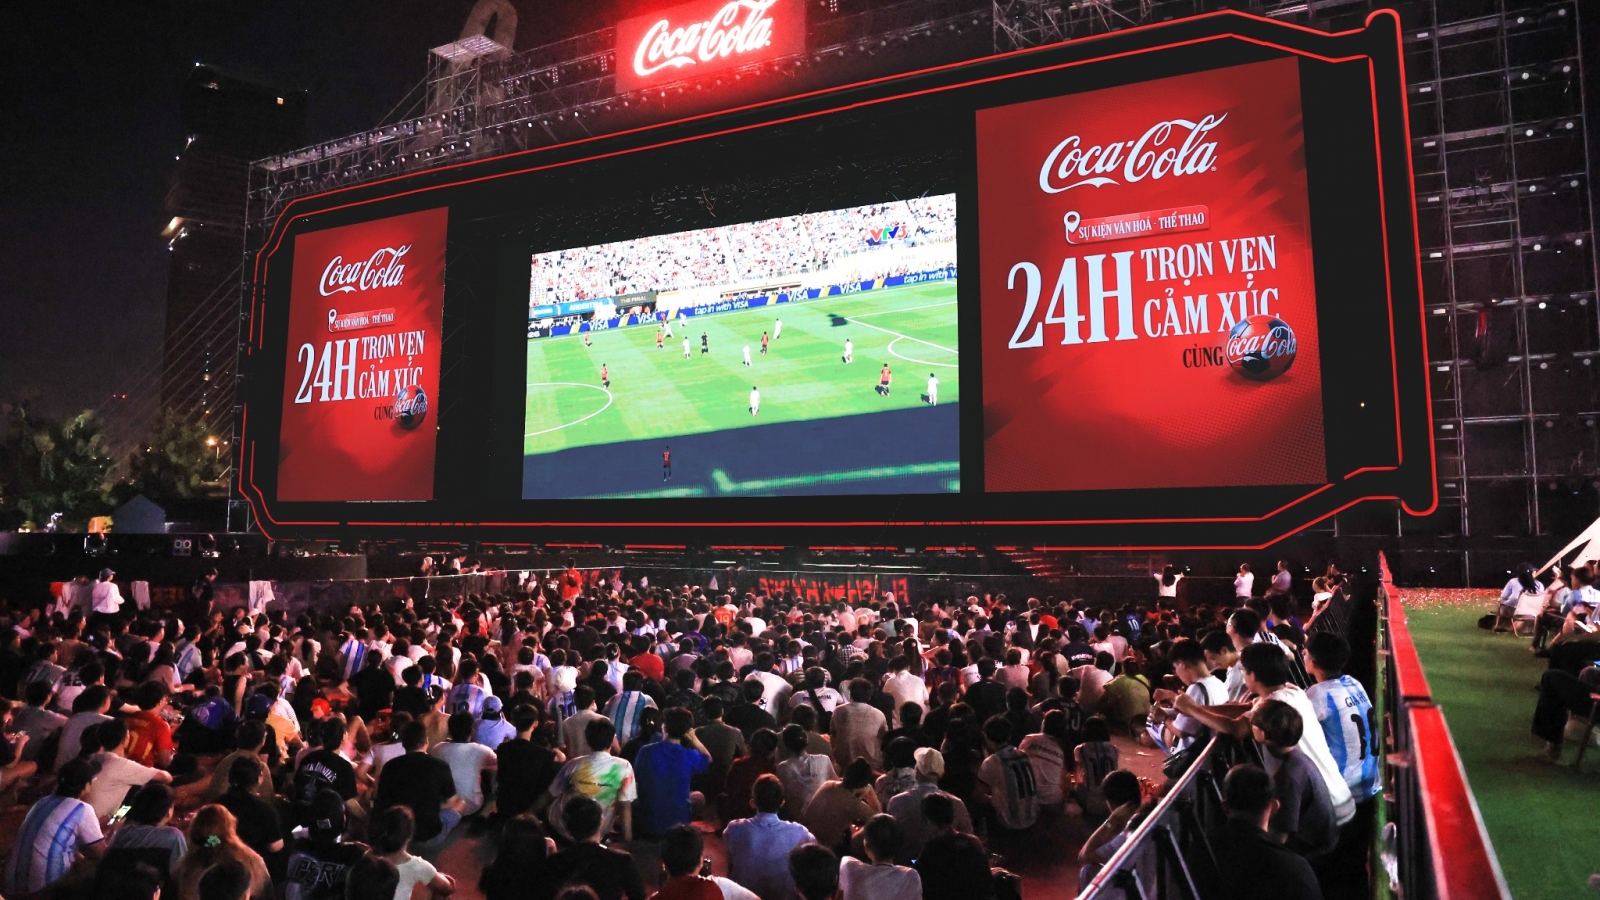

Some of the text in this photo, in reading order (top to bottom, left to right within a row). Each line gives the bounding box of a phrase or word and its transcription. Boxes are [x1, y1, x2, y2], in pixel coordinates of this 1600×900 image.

[634, 0, 777, 76] Coca-Cola
[1039, 112, 1228, 194] Coca-Cola
[870, 225, 907, 243] VTV3
[1079, 225, 1090, 241] SỰ
[1091, 223, 1112, 239] KIỆN
[1113, 221, 1131, 234] VĂN
[1132, 216, 1152, 232] HOÁ
[1158, 211, 1178, 229] THỂ
[1178, 212, 1205, 227] THAO
[319, 244, 412, 297] Coca-Cola
[1140, 235, 1277, 286] TRỌN VẸN
[840, 283, 862, 294] VISA
[904, 273, 918, 283] tap
[918, 272, 927, 281] in
[929, 270, 948, 280] with
[694, 307, 706, 315] tap
[717, 302, 732, 311] with
[733, 299, 749, 309] VISA
[788, 290, 809, 302] VISA
[1006, 250, 1138, 350] 24H
[1142, 281, 1280, 339] CẢM XÚC
[589, 321, 609, 331] VISA
[637, 313, 657, 325] VISA
[361, 330, 425, 363] TRỌN VẸN
[1182, 345, 1225, 369] CÙNG
[1226, 326, 1297, 364] Coca-Cola
[294, 338, 360, 403] 24H
[359, 362, 424, 399] CẢM XÚC
[374, 403, 395, 421] CÙNG
[393, 392, 429, 417] Coca-Cola
[1345, 695, 1361, 708] GIA
[1350, 706, 1380, 761] 10
